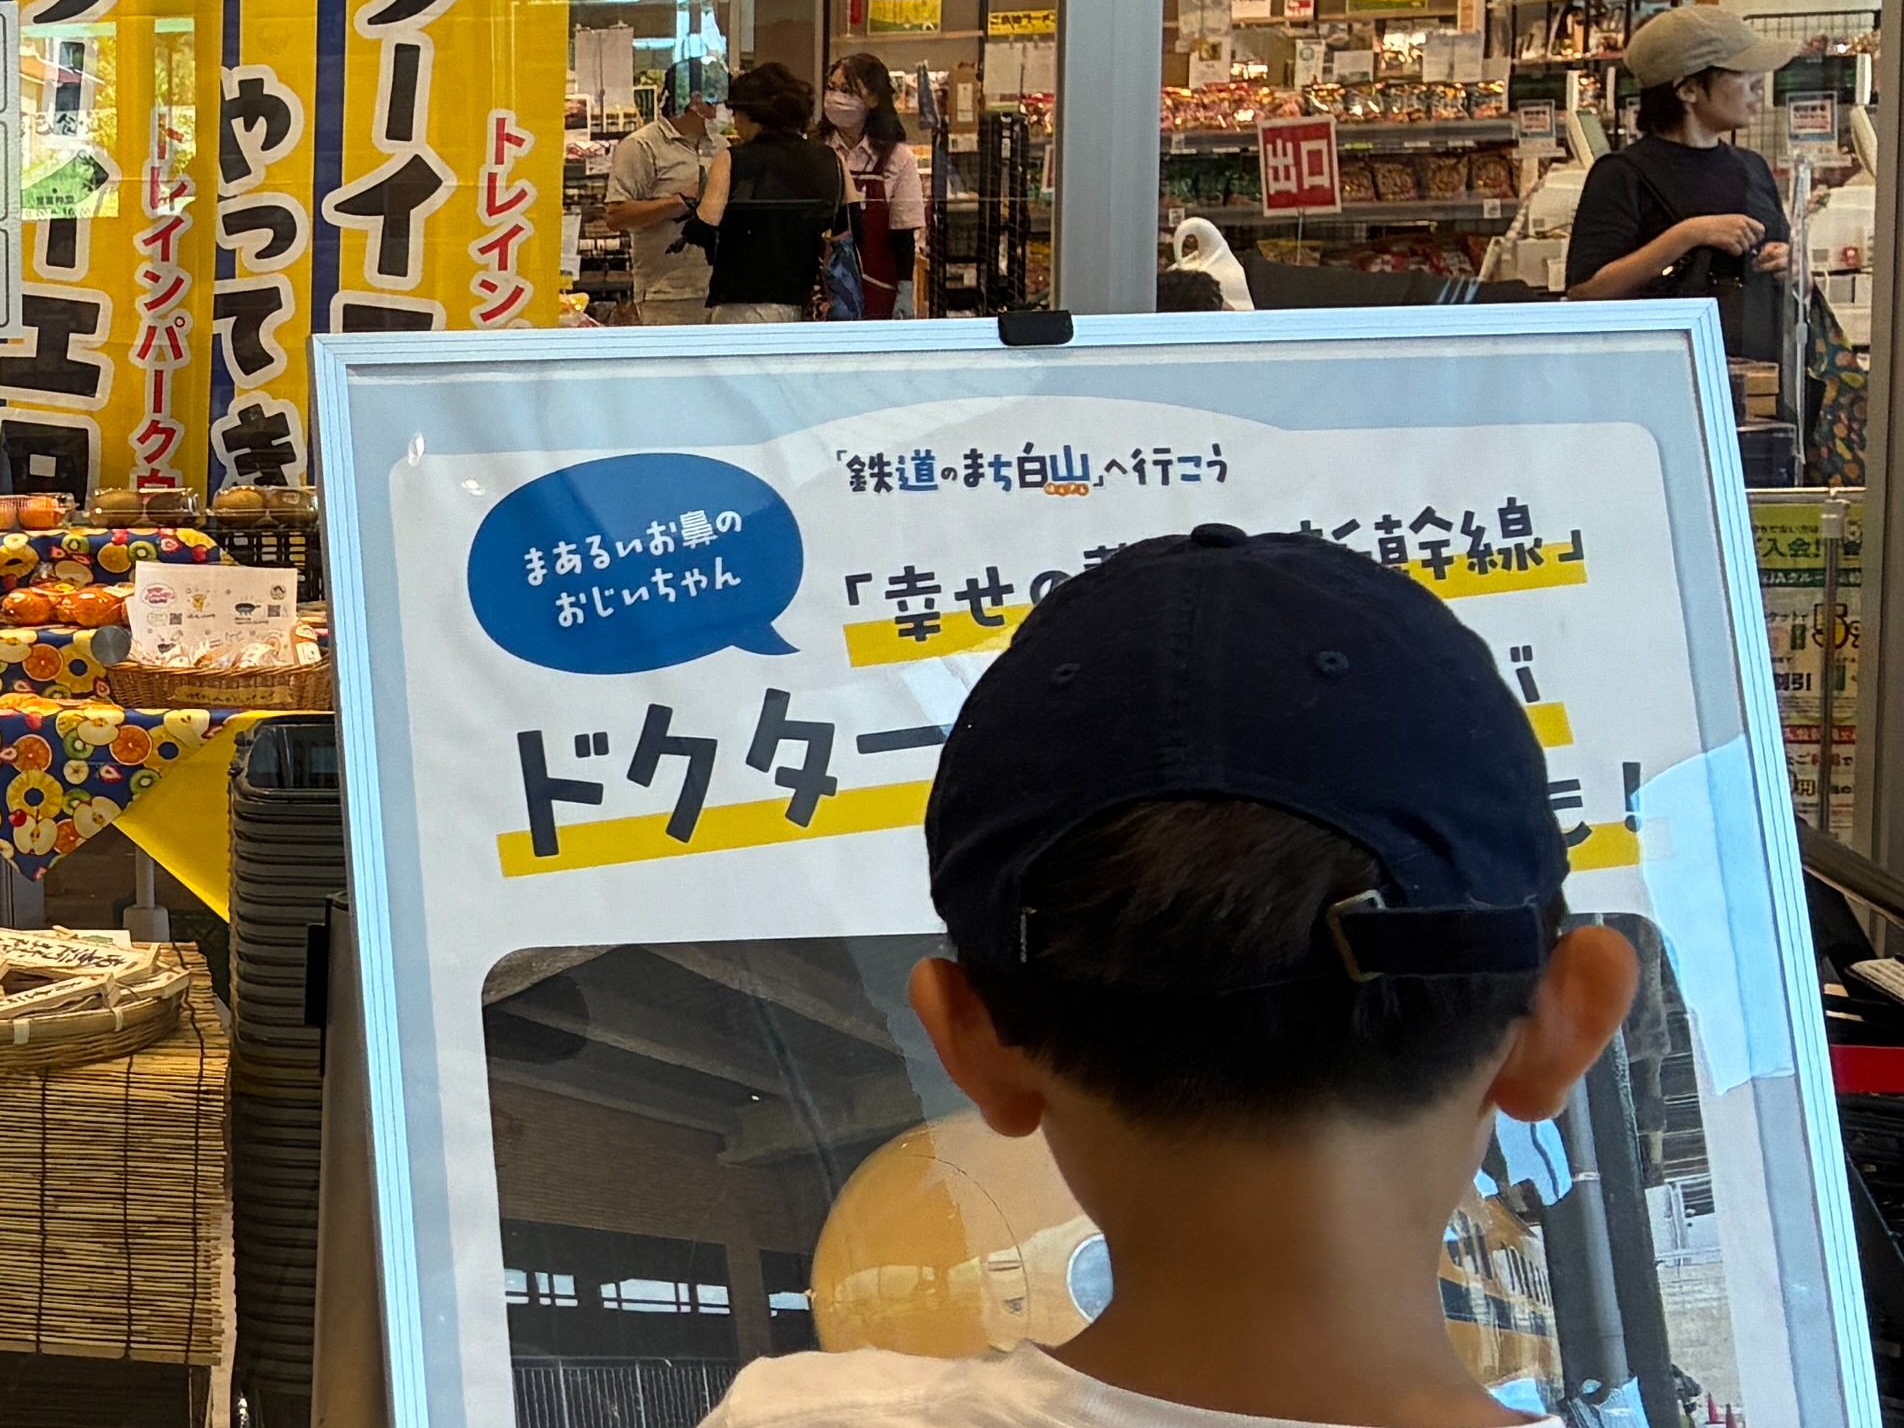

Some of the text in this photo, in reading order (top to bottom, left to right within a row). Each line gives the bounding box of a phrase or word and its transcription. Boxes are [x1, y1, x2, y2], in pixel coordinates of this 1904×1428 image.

[1266, 138, 1330, 195] 出口
[477, 117, 528, 322] トレイン
[836, 442, 1228, 498] 「鉄道のまち白山」へ行こう
[523, 510, 743, 588] まあるいお鼻の
[556, 557, 741, 627] おじいちゃん
